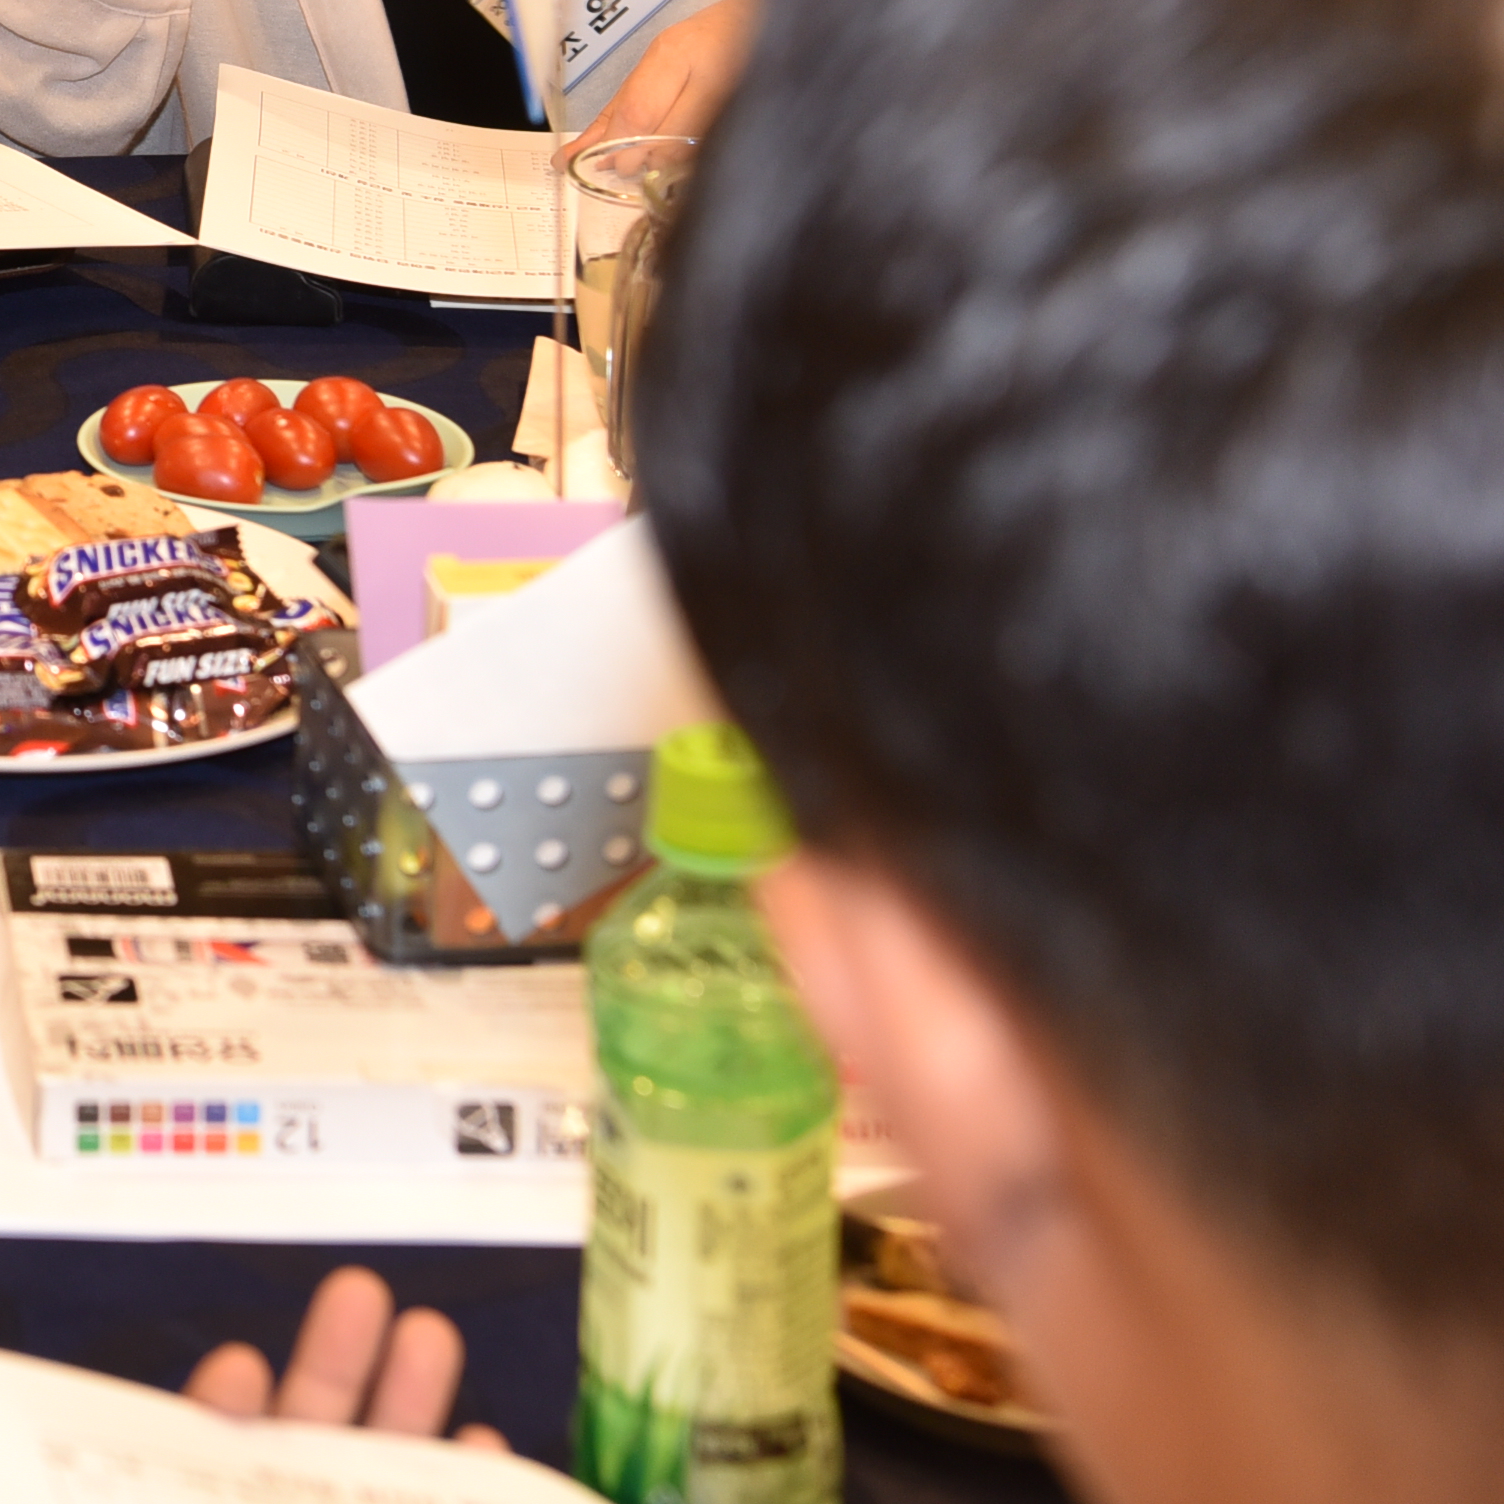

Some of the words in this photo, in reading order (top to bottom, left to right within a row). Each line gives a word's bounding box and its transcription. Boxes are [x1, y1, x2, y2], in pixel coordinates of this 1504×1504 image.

[143, 655, 197, 687] FUN
[196, 648, 252, 679] SIZE
[275, 1114, 321, 1154] 12
